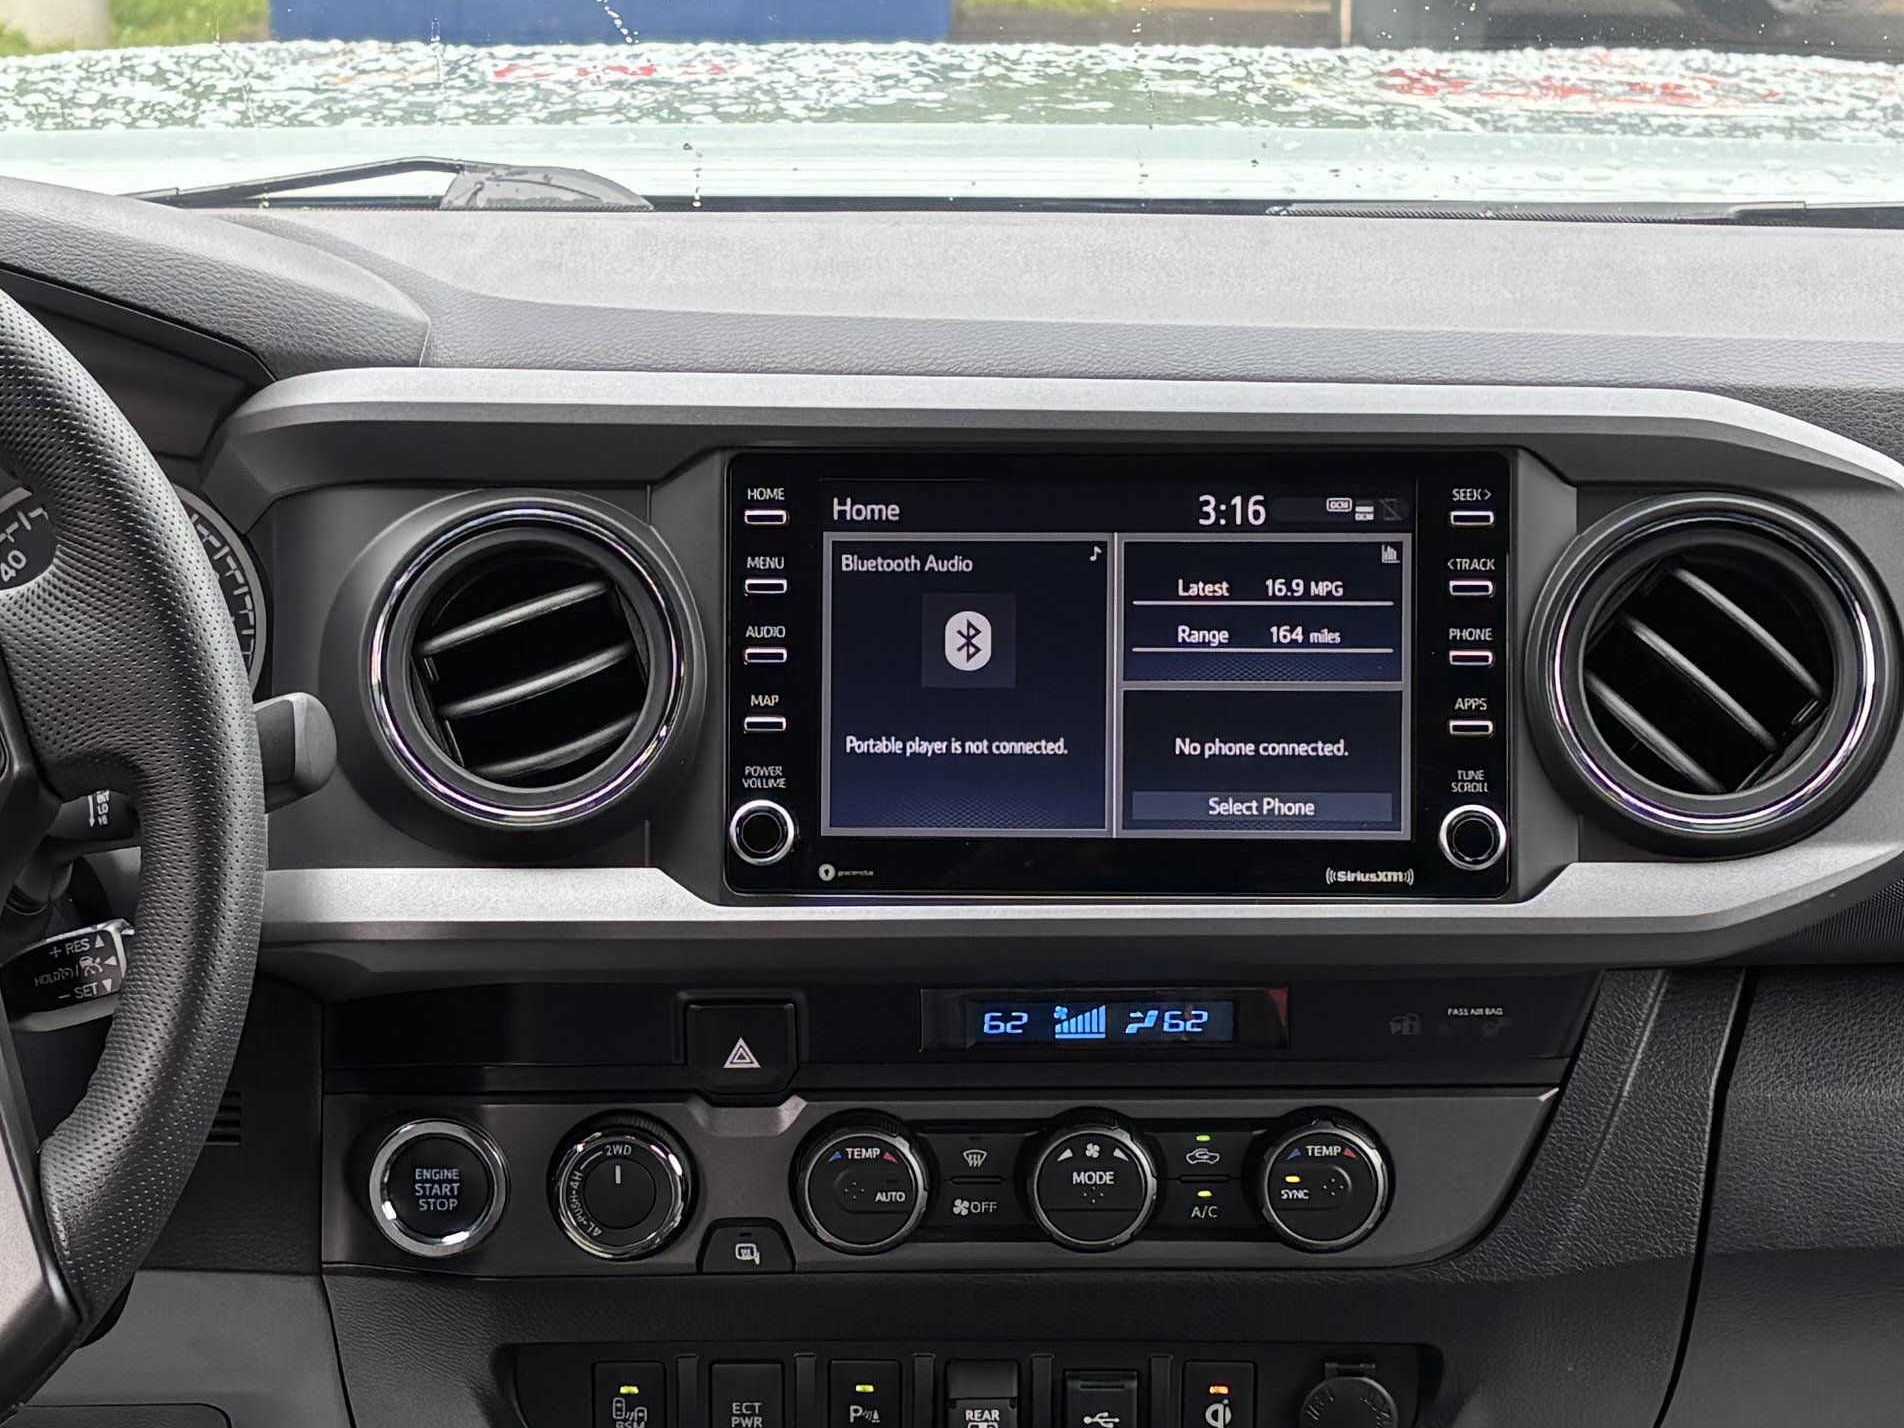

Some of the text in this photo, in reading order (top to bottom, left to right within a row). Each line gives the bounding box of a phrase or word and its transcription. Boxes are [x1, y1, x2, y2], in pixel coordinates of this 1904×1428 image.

[746, 488, 786, 501] HOME
[833, 497, 900, 522] Home
[1198, 494, 1267, 526] 3:16
[0, 549, 27, 583] 40
[746, 556, 785, 570] MENU
[841, 554, 973, 573] Bluetooth Audio
[1177, 578, 1344, 598] Latest 16.9 MPG
[745, 625, 786, 639] AUDIO
[1177, 625, 1342, 647] Range 164 miles
[1448, 628, 1493, 642] PHONE
[750, 694, 780, 707] MAP
[1454, 697, 1487, 711] APPS
[845, 735, 1068, 757] Portable player is not connected.
[1175, 738, 1349, 760] No phone connected.
[744, 765, 784, 777] POWER
[1456, 770, 1485, 781] TUNE
[742, 777, 787, 790] VOLUME
[1450, 781, 1488, 793] SCROLL
[1208, 797, 1316, 817] Select Phone
[65, 938, 91, 954] RES
[75, 983, 99, 999] SET
[982, 1011, 1028, 1034] 62
[1162, 1010, 1209, 1034] 62
[604, 1144, 633, 1157] 2WD
[845, 1147, 881, 1159] TEMP
[1305, 1144, 1342, 1157] TEMP
[414, 1167, 460, 1181] ENGINE
[1072, 1171, 1115, 1186] MODE
[414, 1182, 461, 1197] START
[1281, 1188, 1310, 1201] SYNC
[418, 1197, 458, 1211] STOP
[875, 1191, 906, 1203] AUTO
[969, 1201, 998, 1214] OFF
[1191, 1205, 1218, 1220] A/C
[732, 1402, 762, 1415] ECT
[965, 1409, 1001, 1422] REAR
[731, 1416, 763, 1428] PWR
